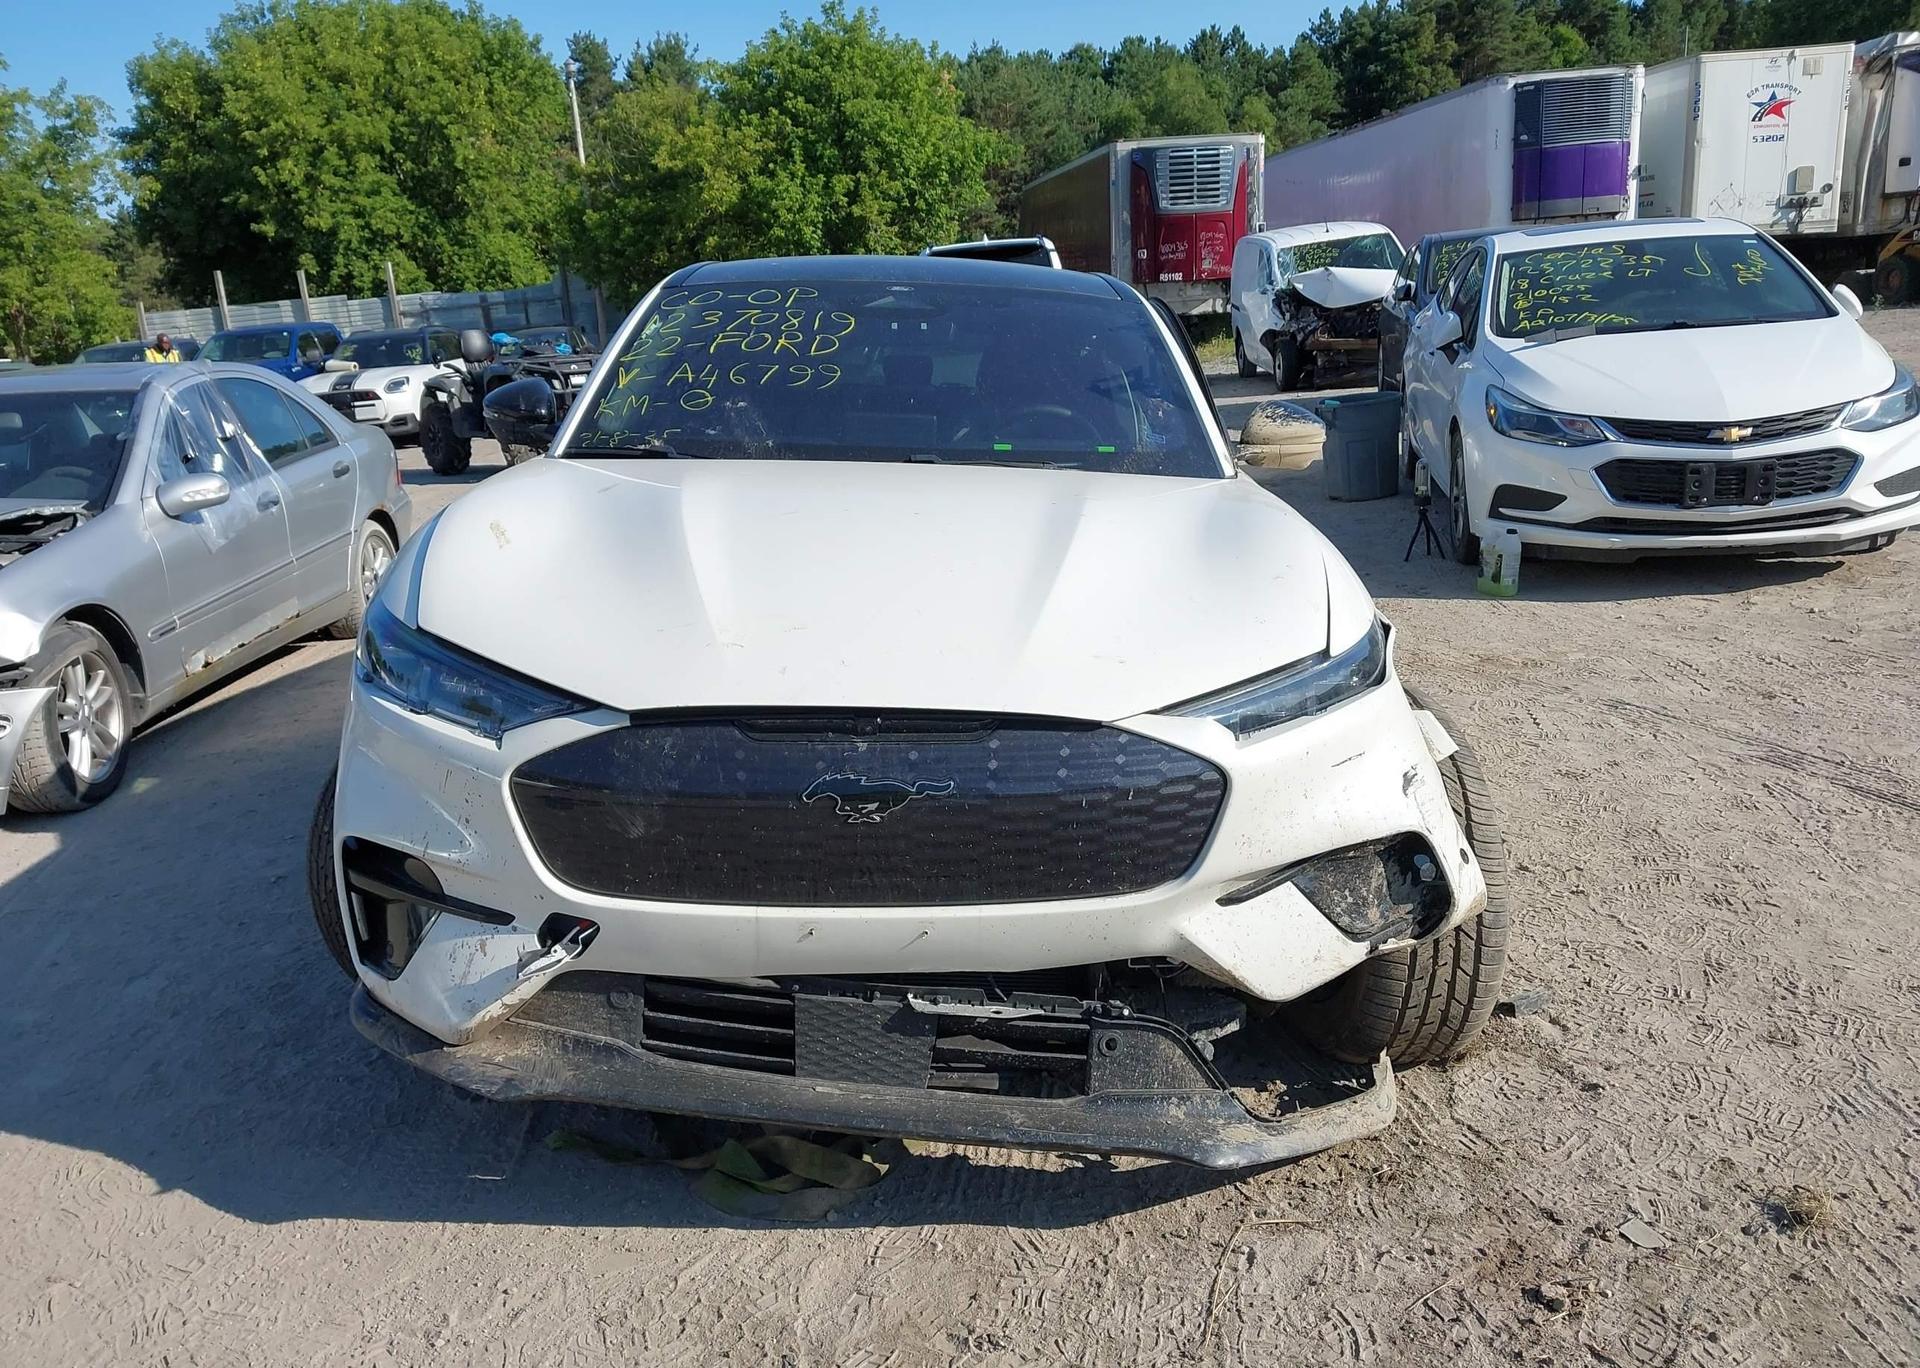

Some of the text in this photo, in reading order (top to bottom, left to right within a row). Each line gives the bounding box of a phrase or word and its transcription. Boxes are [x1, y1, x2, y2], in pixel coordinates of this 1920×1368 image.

[1761, 82, 1802, 96] TRANSPORT
[1752, 133, 1785, 143] 53202
[1510, 279, 1529, 290] 18
[1629, 268, 1658, 277] LT
[661, 287, 818, 309] CO-OP
[619, 331, 840, 361] 22-FORD
